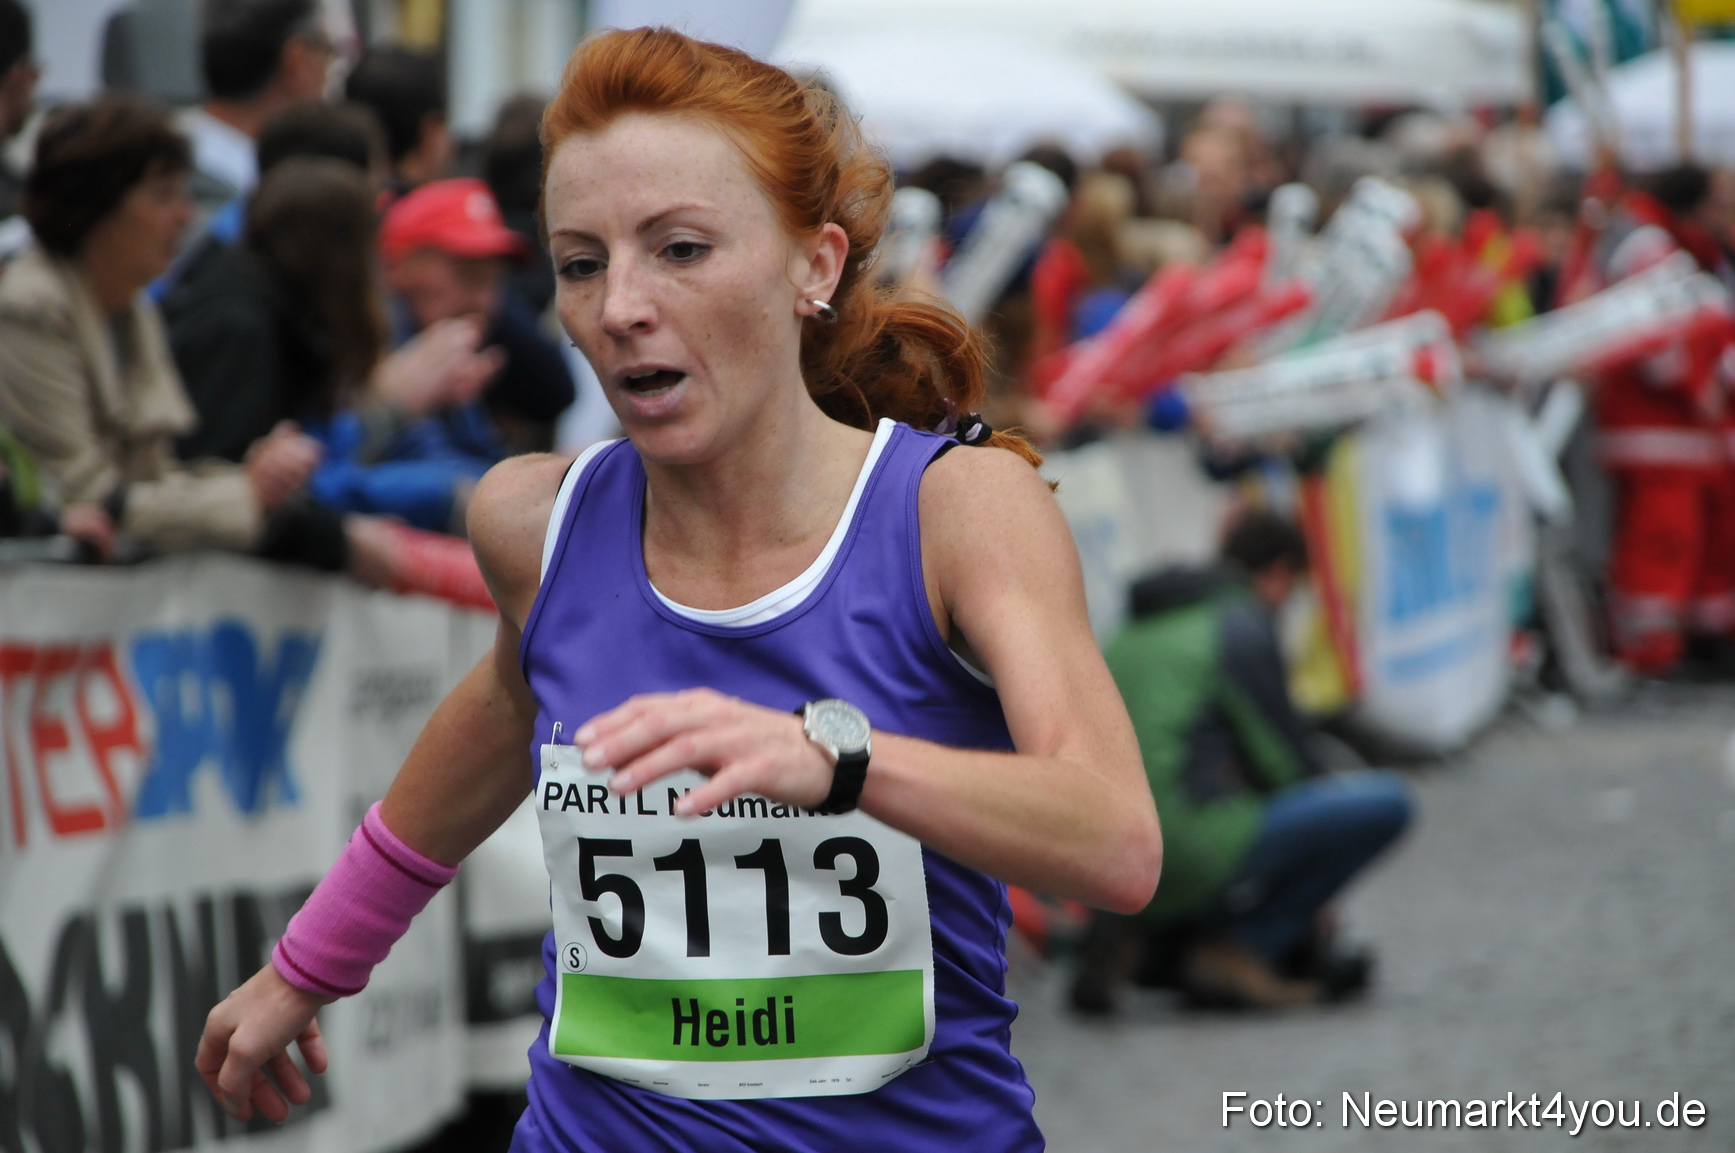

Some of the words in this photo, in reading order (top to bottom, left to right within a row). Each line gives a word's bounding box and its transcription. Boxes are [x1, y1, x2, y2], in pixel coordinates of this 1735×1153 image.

[577, 836, 889, 959] 5113
[569, 946, 581, 969] S
[671, 996, 796, 1048] Heidi
